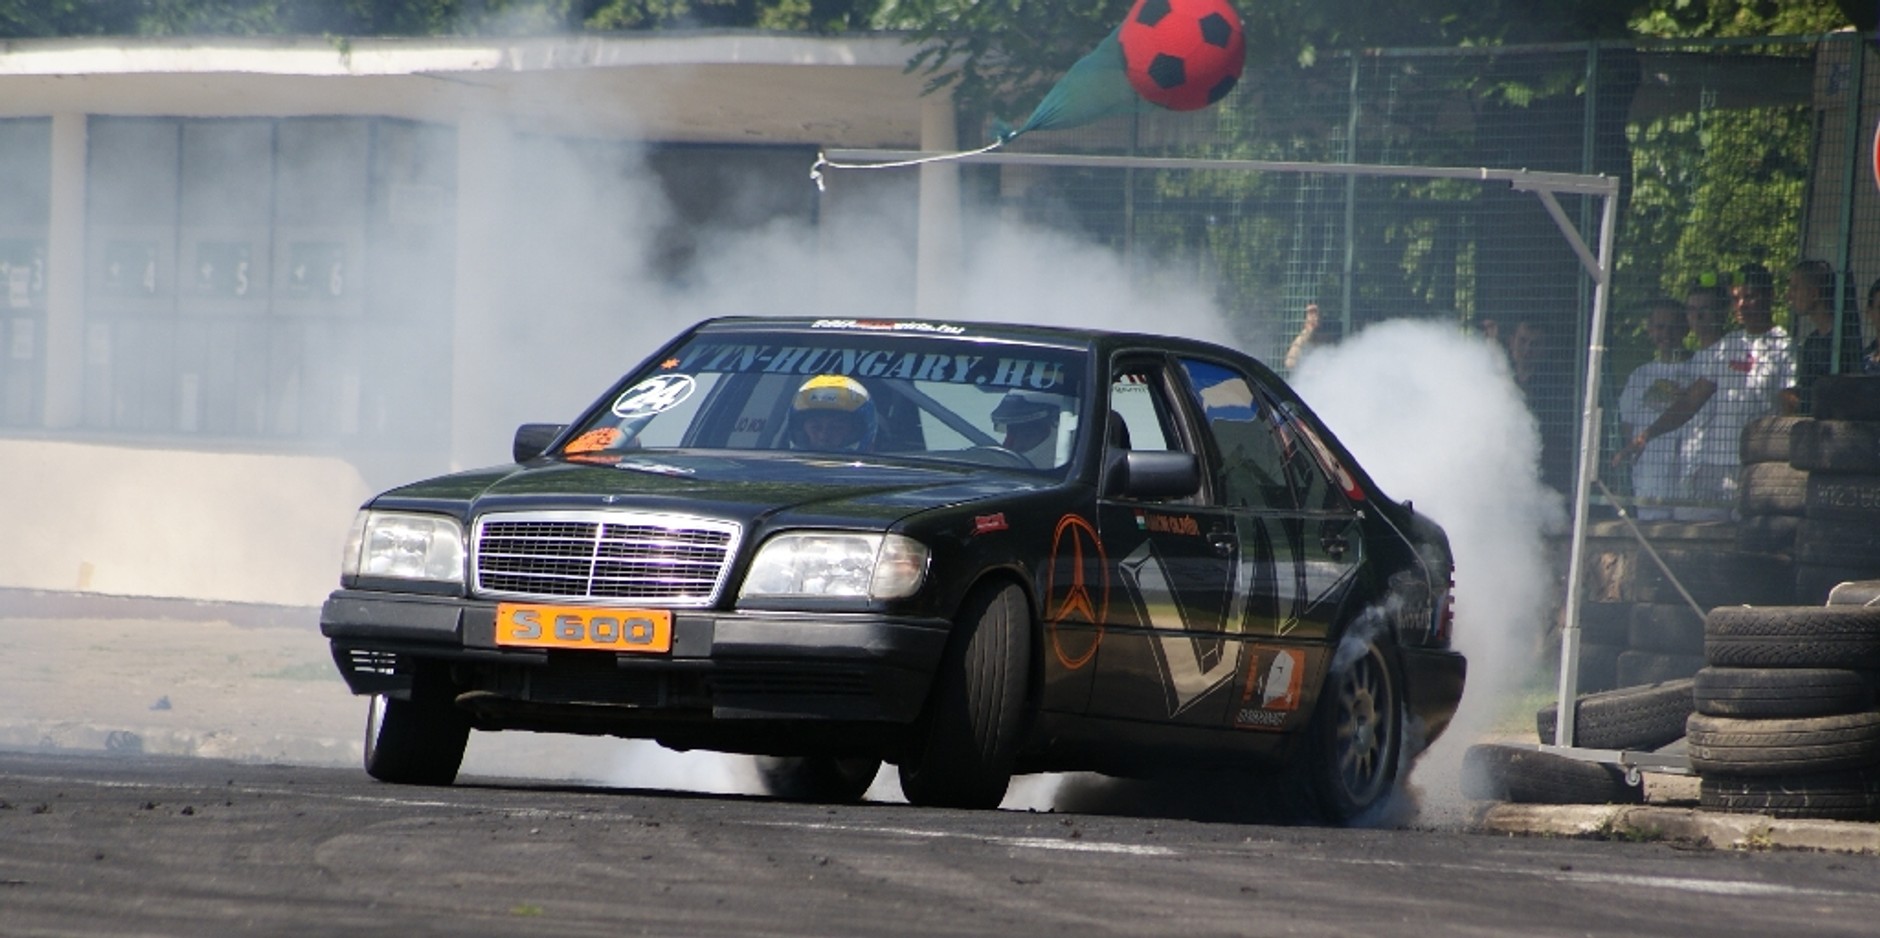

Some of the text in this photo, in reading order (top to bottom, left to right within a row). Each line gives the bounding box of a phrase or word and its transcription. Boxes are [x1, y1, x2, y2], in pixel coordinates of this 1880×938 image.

[143, 261, 155, 293] 4
[235, 261, 248, 295] 5
[328, 261, 342, 296] 6
[679, 344, 1064, 389] VTN-HUNGARY.HU
[616, 378, 690, 412] 24
[512, 609, 655, 645] S 600
